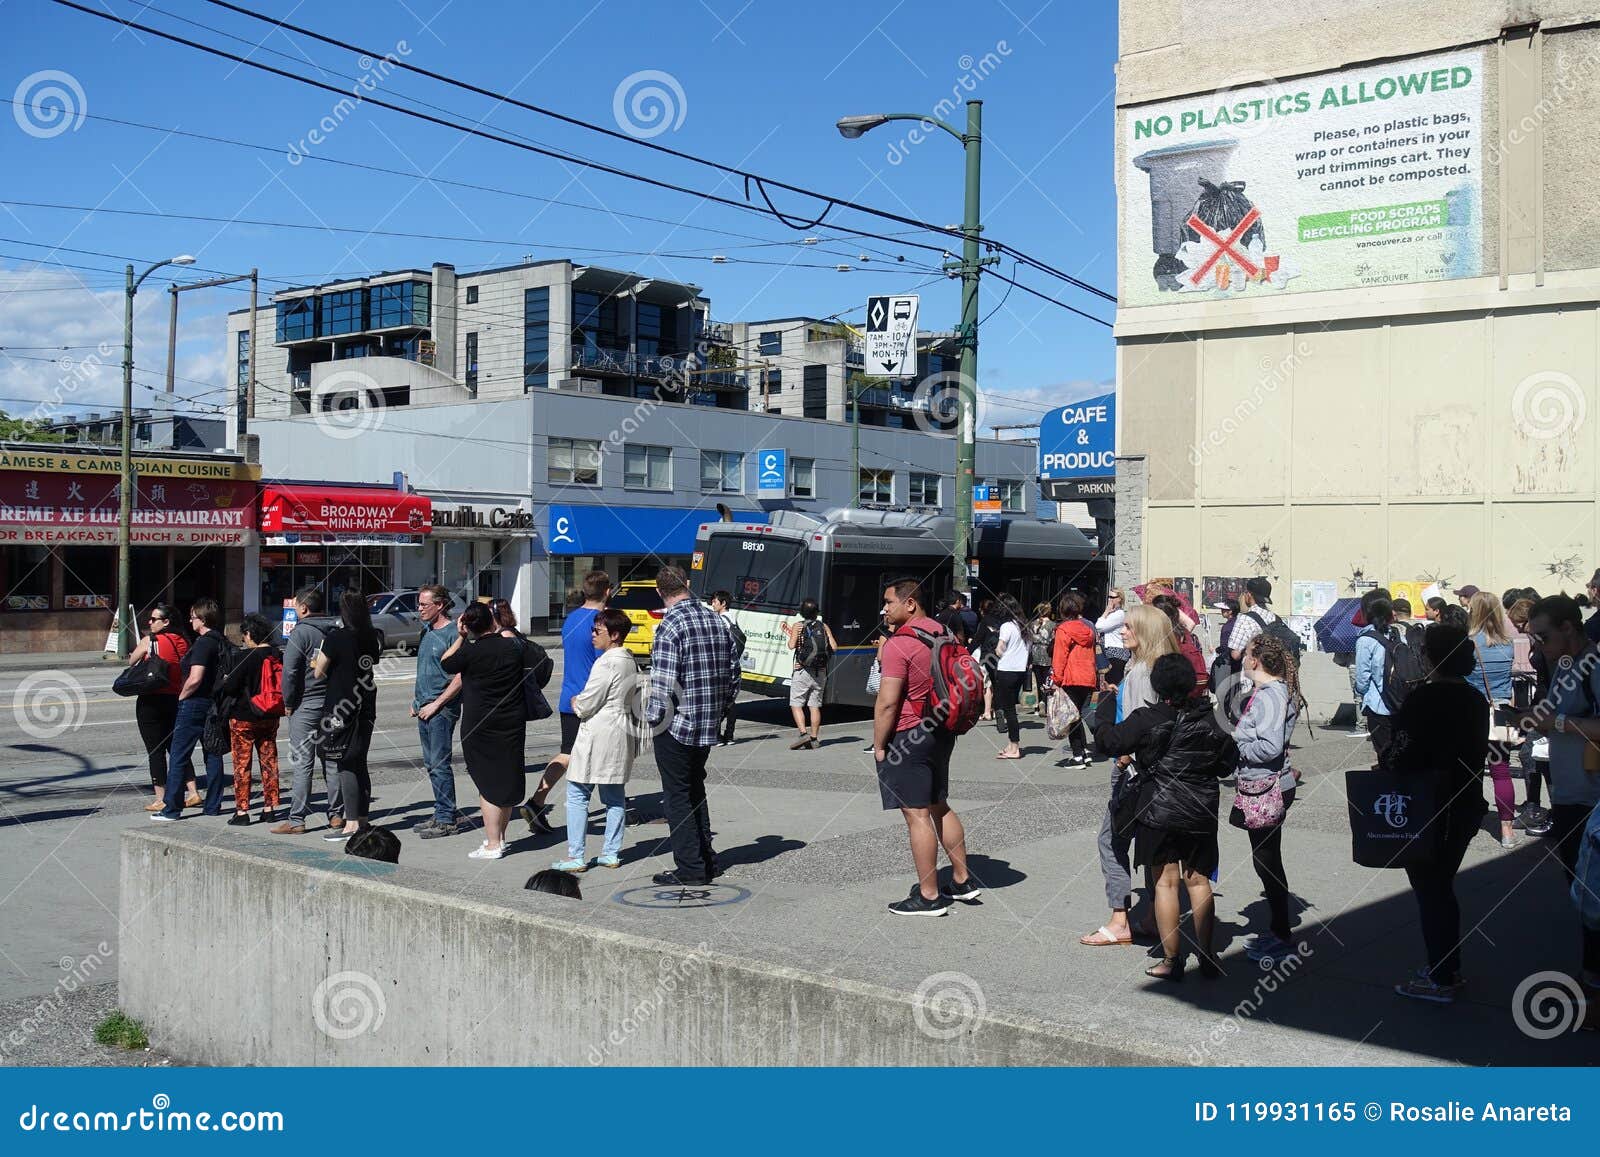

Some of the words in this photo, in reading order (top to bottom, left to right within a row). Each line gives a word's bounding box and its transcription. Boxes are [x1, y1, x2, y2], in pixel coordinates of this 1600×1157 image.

[1134, 115, 1173, 140] NO
[1180, 91, 1311, 133] PLASTICS
[1318, 65, 1473, 110] ALLOWED
[1313, 128, 1360, 142] Please,
[1363, 124, 1380, 135] no
[1384, 115, 1429, 133] plastic
[1432, 112, 1471, 125] bags,
[1295, 149, 1327, 161] wrap
[1330, 147, 1345, 156] or
[1348, 135, 1418, 154] containers
[1422, 133, 1435, 144] in
[1439, 129, 1471, 144] your
[1297, 163, 1326, 180] yard
[1329, 156, 1397, 173] trimmings
[1400, 151, 1432, 164] cart.
[1436, 147, 1471, 159] They
[1319, 176, 1366, 192] cannot
[1369, 174, 1385, 185] be
[1388, 163, 1472, 182] composted.
[1350, 210, 1386, 224] FOOD
[1388, 203, 1441, 219] SCRAPS
[1302, 222, 1373, 240] RECYCLING
[1375, 215, 1441, 232] PROGRAM
[1356, 236, 1413, 249] vancouver.ca
[1427, 232, 1443, 241] call
[1061, 405, 1107, 425] CAFE
[1076, 428, 1089, 445] &
[1, 456, 54, 469] AMESE
[60, 459, 71, 469] &
[178, 464, 231, 477] CUISINE
[60, 506, 85, 523] XE
[131, 508, 243, 526] RESTAURANT
[320, 505, 396, 519] BROADWAY
[489, 507, 534, 529] Cafe
[328, 517, 388, 529] MINI-MART
[24, 530, 117, 542] BREAKFAST,
[129, 532, 171, 542] UNCH
[176, 533, 185, 542] &
[191, 533, 241, 543] DINNER
